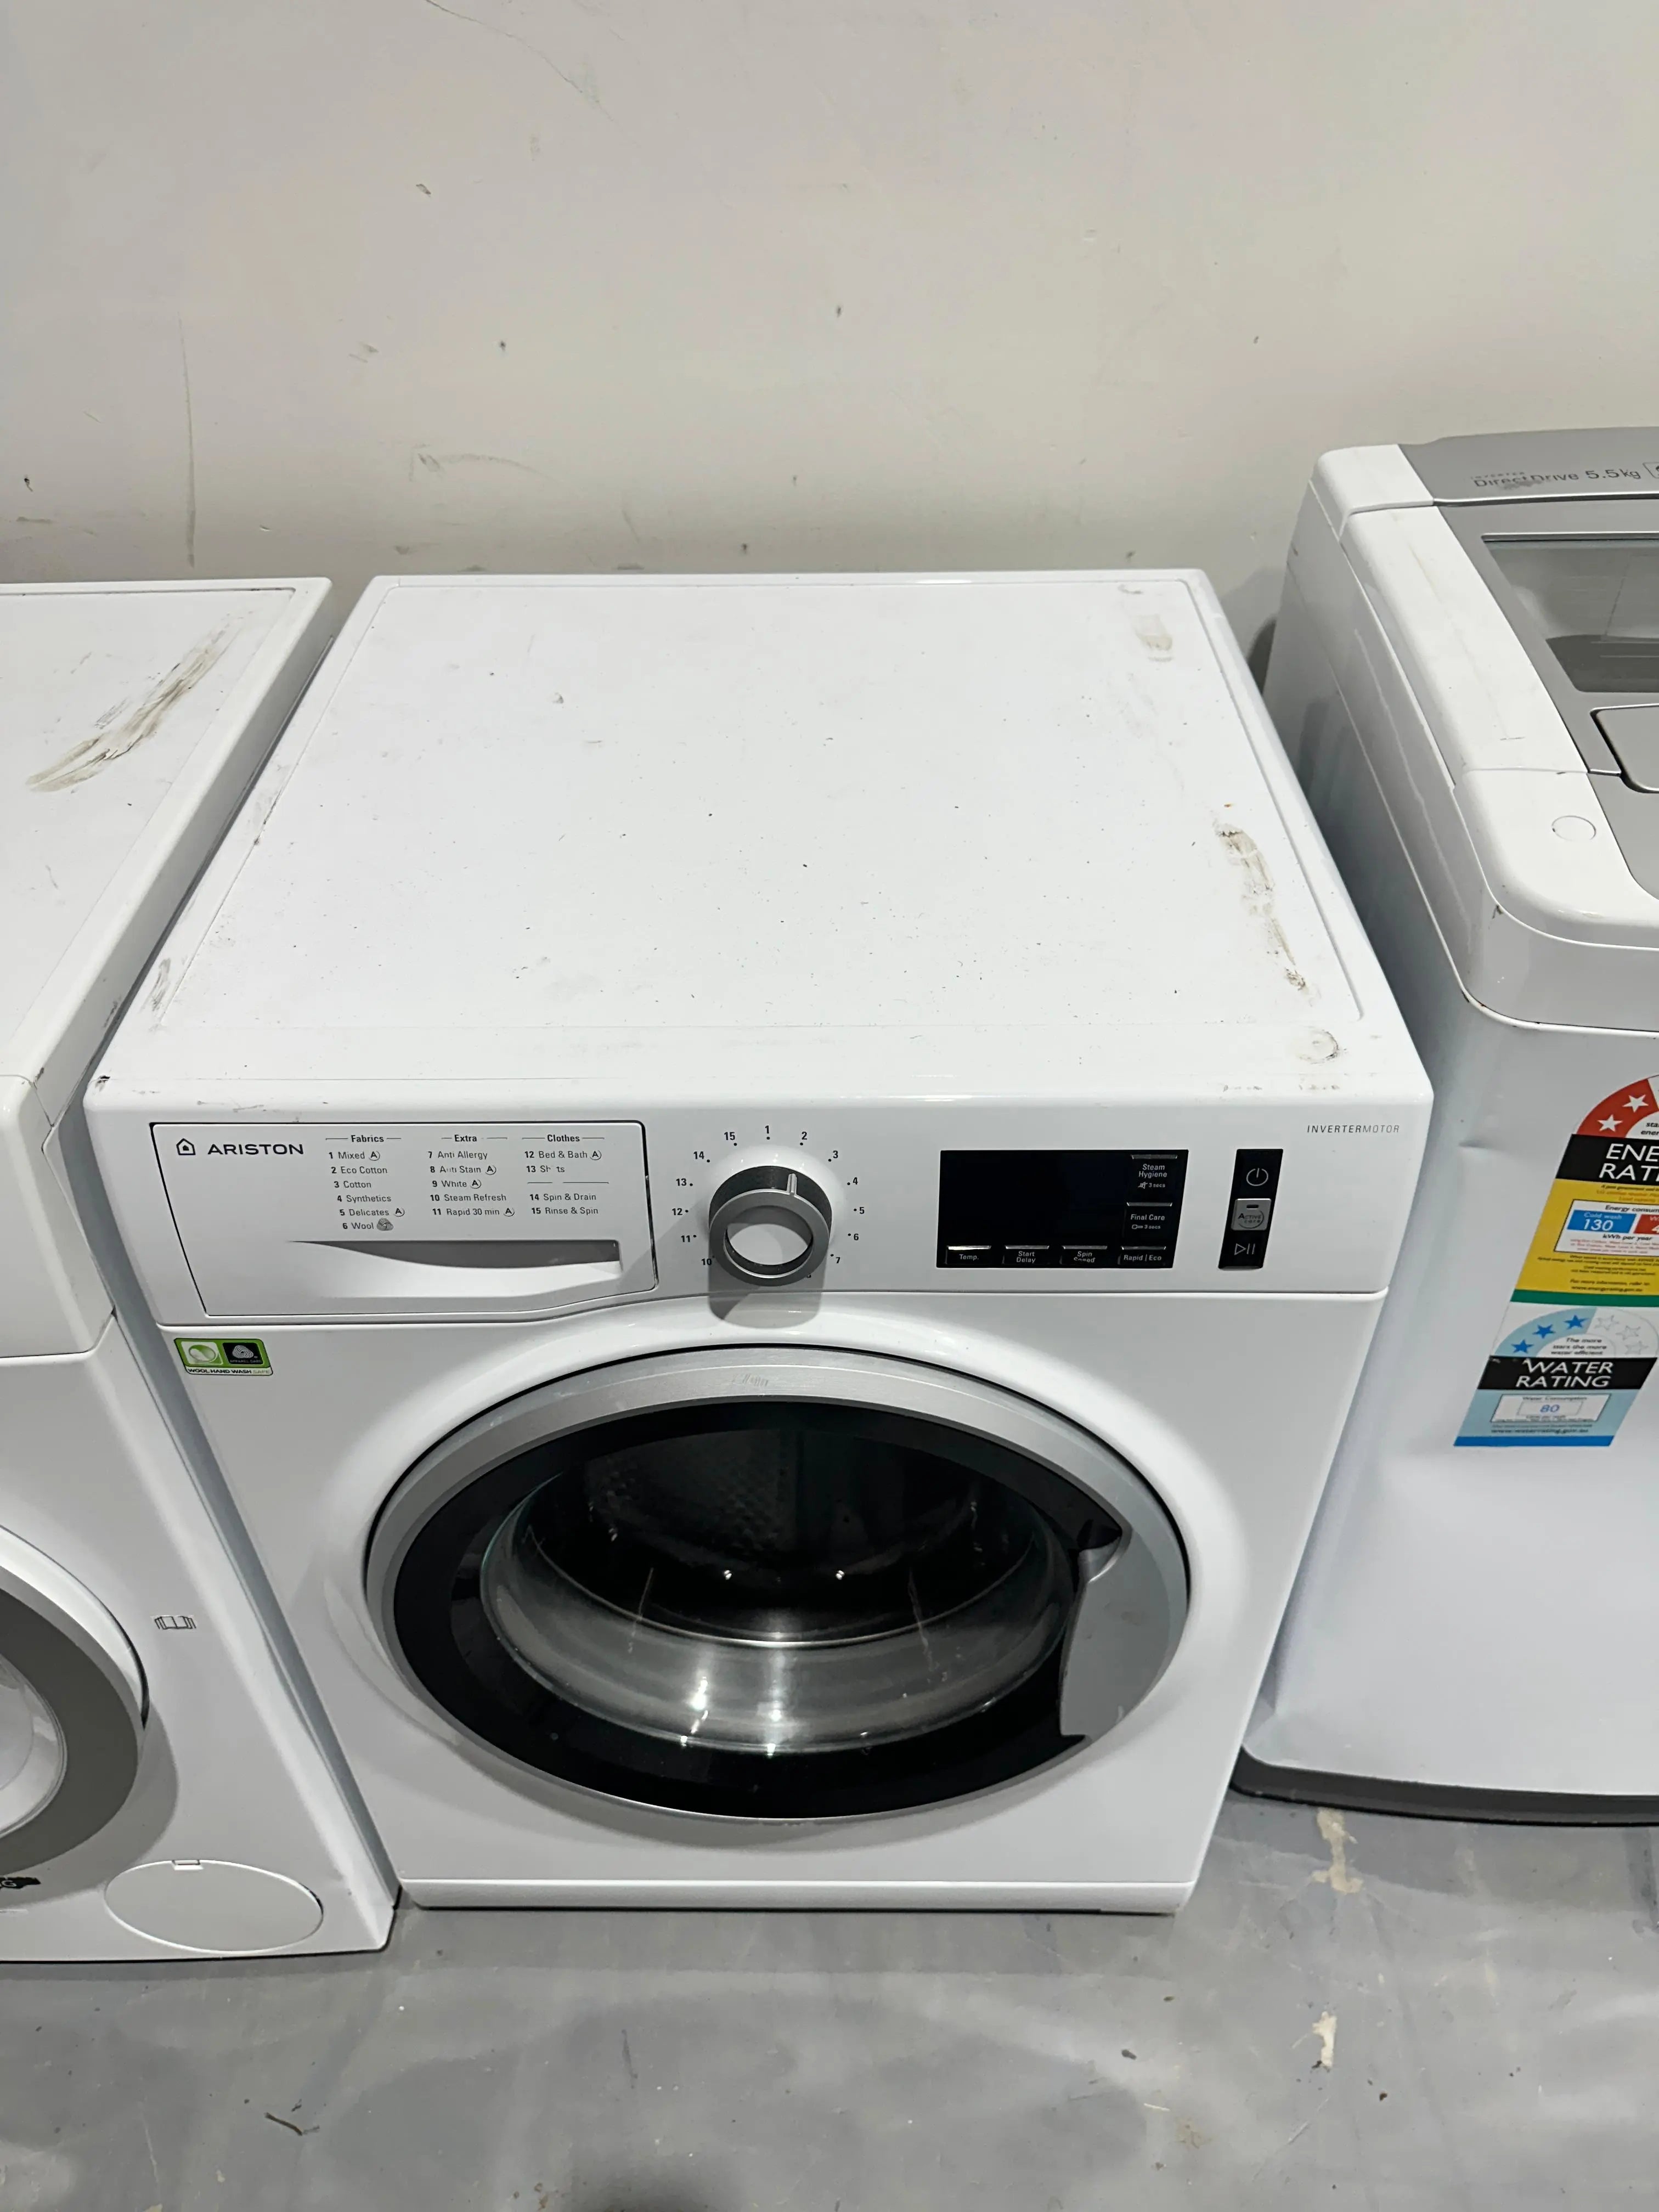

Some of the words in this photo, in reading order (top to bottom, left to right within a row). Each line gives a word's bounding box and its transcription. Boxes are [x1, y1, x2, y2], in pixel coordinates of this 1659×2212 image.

[765, 1126, 770, 1134] 1
[724, 1132, 736, 1141] 15
[802, 1132, 808, 1140] 2
[207, 1144, 304, 1155] ARISTON
[458, 1151, 488, 1160] Allergy
[693, 1152, 704, 1160] 14
[833, 1150, 838, 1159] 3
[1599, 1163, 1659, 1182] RAT
[676, 1178, 687, 1187] 13
[346, 1194, 392, 1203] Synthetics
[544, 1193, 562, 1202] Spin
[447, 1208, 470, 1217] Rapid
[1584, 1218, 1613, 1231] 130
[1524, 1358, 1613, 1374] WATER
[1516, 1375, 1610, 1388] RATING
[1540, 1404, 1560, 1413] 80
